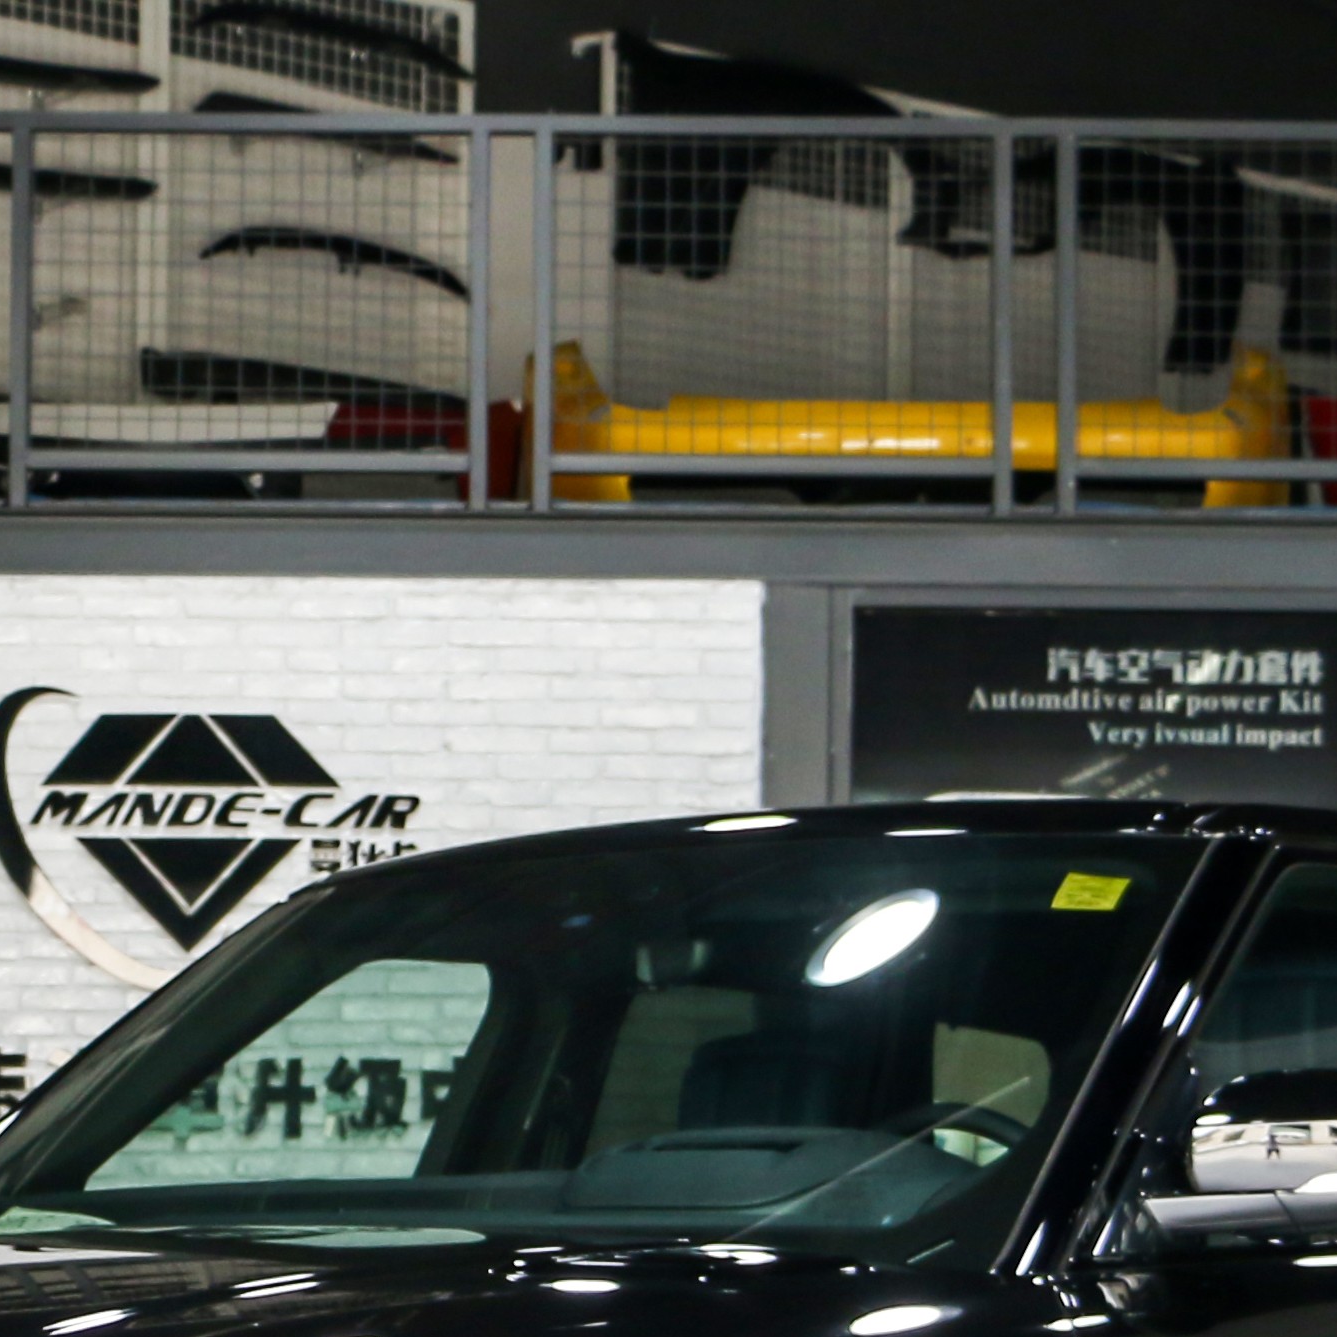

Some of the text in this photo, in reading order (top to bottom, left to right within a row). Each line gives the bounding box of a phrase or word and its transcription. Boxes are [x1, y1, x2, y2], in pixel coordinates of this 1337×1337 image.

[1138, 688, 1179, 712] air
[1186, 694, 1274, 718] power
[1278, 689, 1323, 713] Kit
[1088, 720, 1147, 749] Very
[1235, 723, 1323, 750] impact
[30, 790, 420, 829] MANDE-CAR
